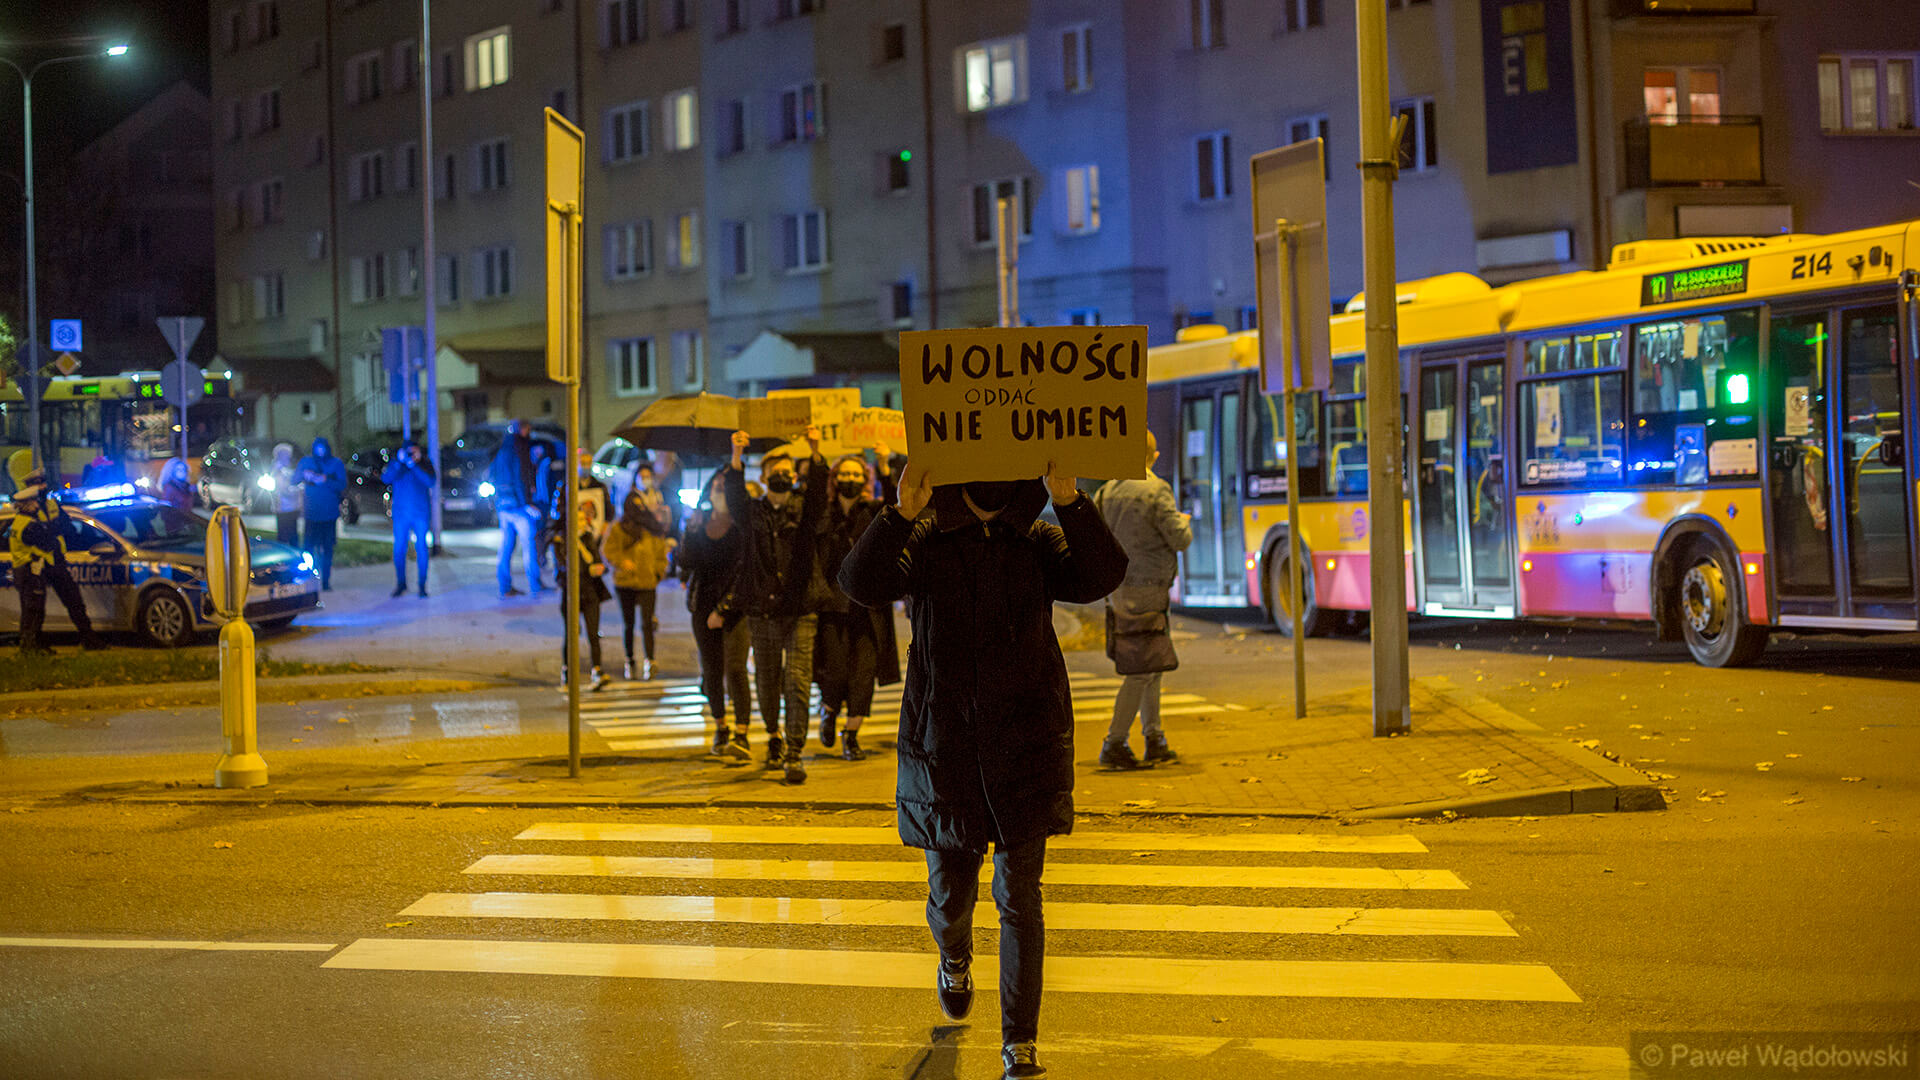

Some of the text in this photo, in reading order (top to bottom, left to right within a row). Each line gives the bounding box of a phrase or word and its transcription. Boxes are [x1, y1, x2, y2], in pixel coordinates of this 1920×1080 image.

[1791, 251, 1832, 280] 214
[922, 333, 1140, 384] WOLNOŚCI
[815, 394, 849, 408] UCJA
[965, 379, 1036, 407] ODDAĆ
[923, 410, 982, 443] NIE
[1011, 405, 1127, 441] UMIEM
